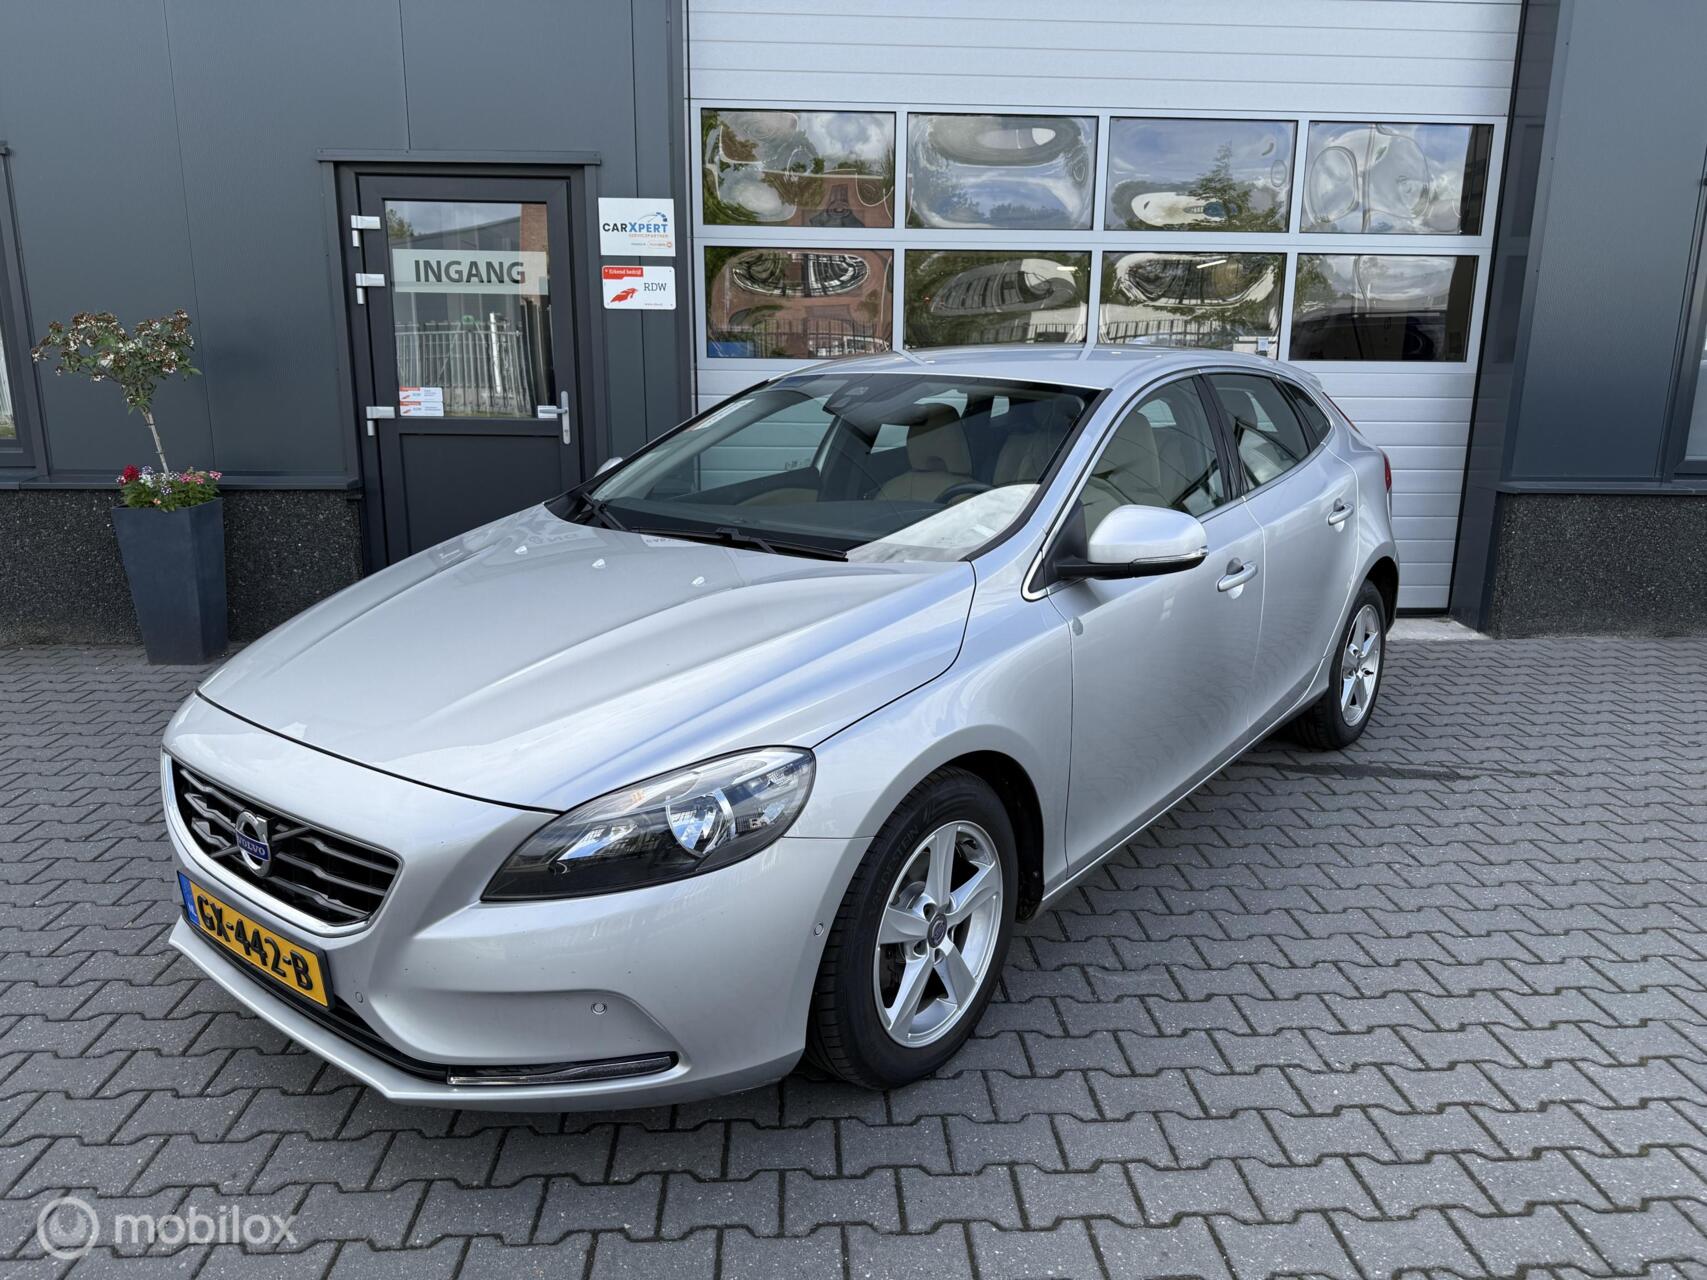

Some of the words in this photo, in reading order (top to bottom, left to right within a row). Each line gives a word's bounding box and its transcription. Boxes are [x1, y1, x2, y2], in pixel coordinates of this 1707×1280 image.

[602, 222, 668, 233] CARXPERT
[413, 259, 526, 284] INGANG
[643, 282, 667, 292] RDW
[238, 835, 266, 856] VOLVO
[197, 895, 313, 991] GX-442-B
